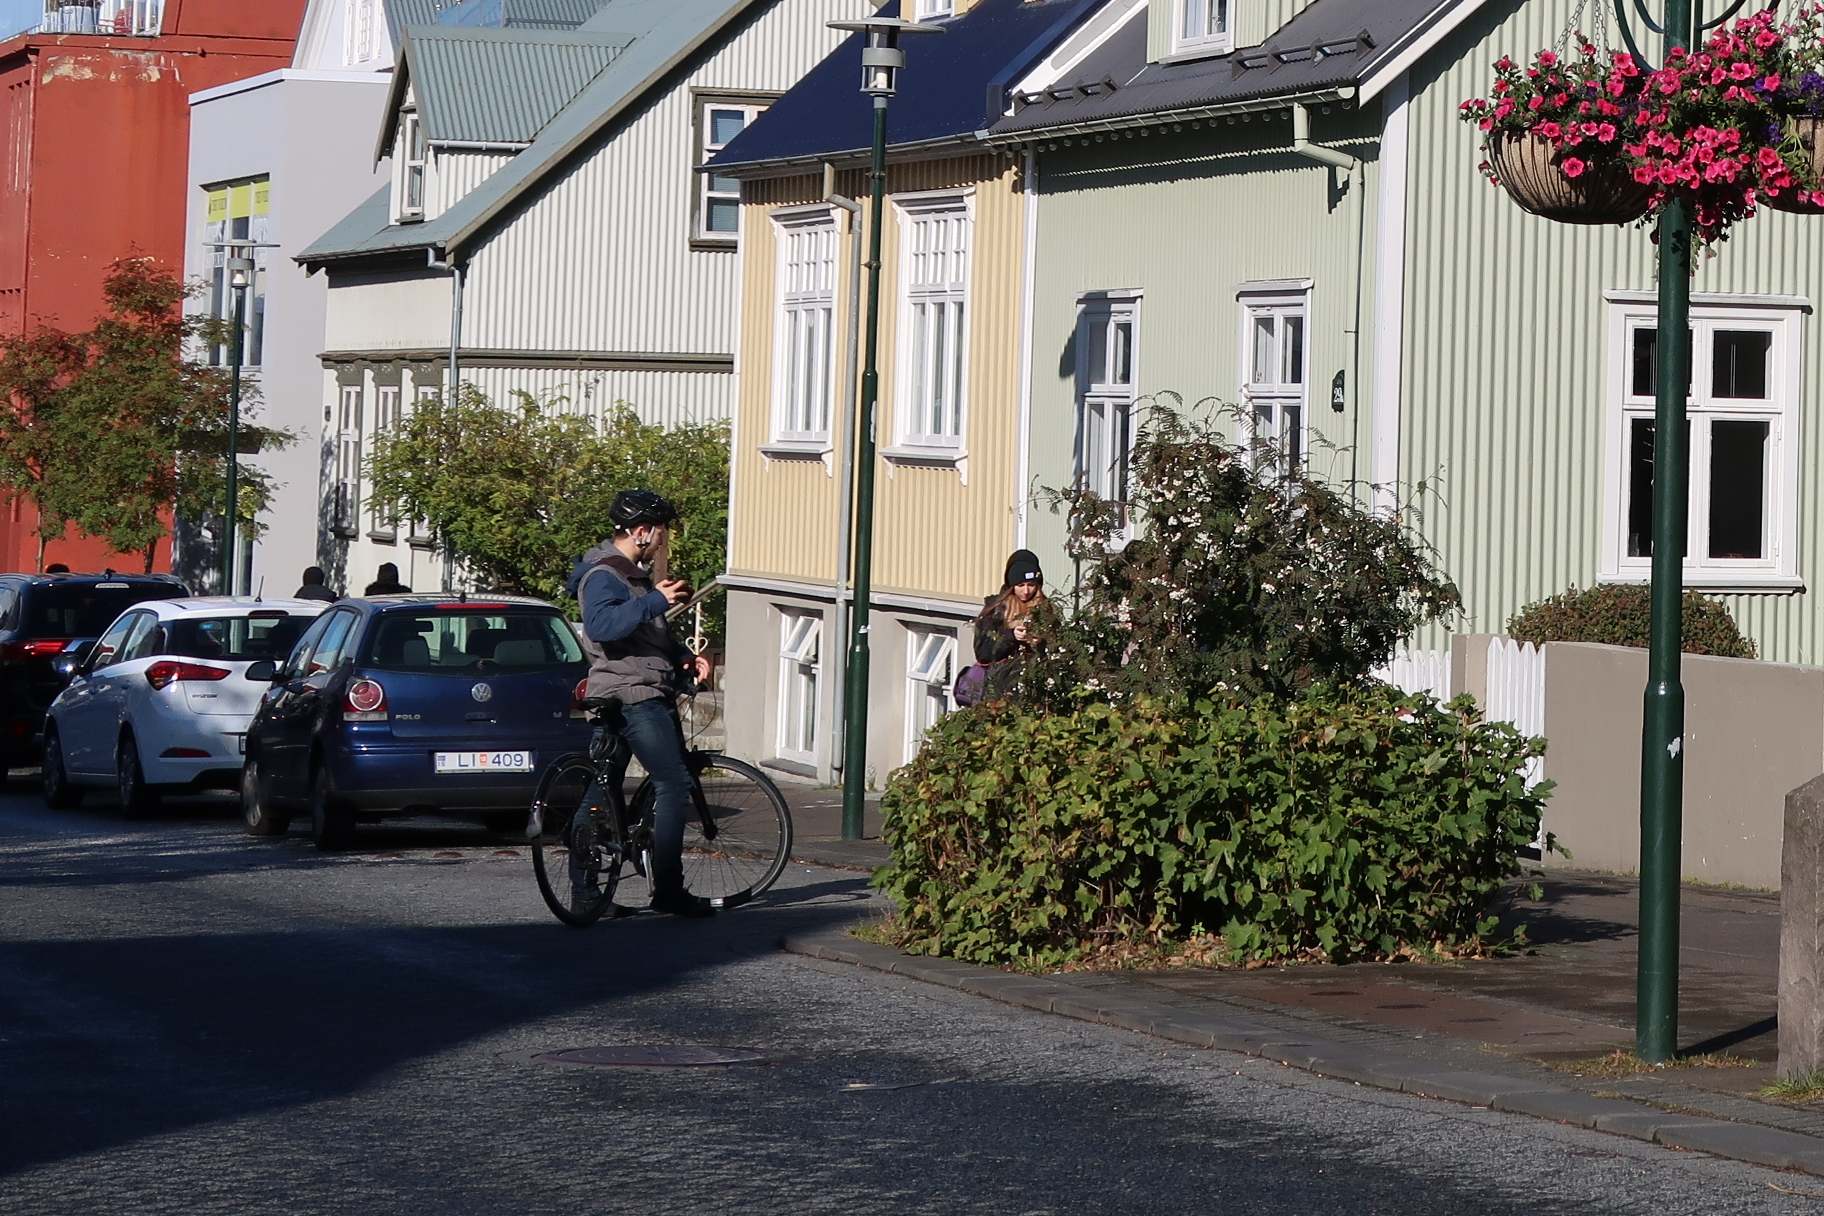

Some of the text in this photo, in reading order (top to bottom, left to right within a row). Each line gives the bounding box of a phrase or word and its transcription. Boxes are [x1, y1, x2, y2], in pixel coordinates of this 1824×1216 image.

[395, 713, 421, 721] POLO
[458, 753, 475, 767] LI
[491, 753, 524, 767] 409
